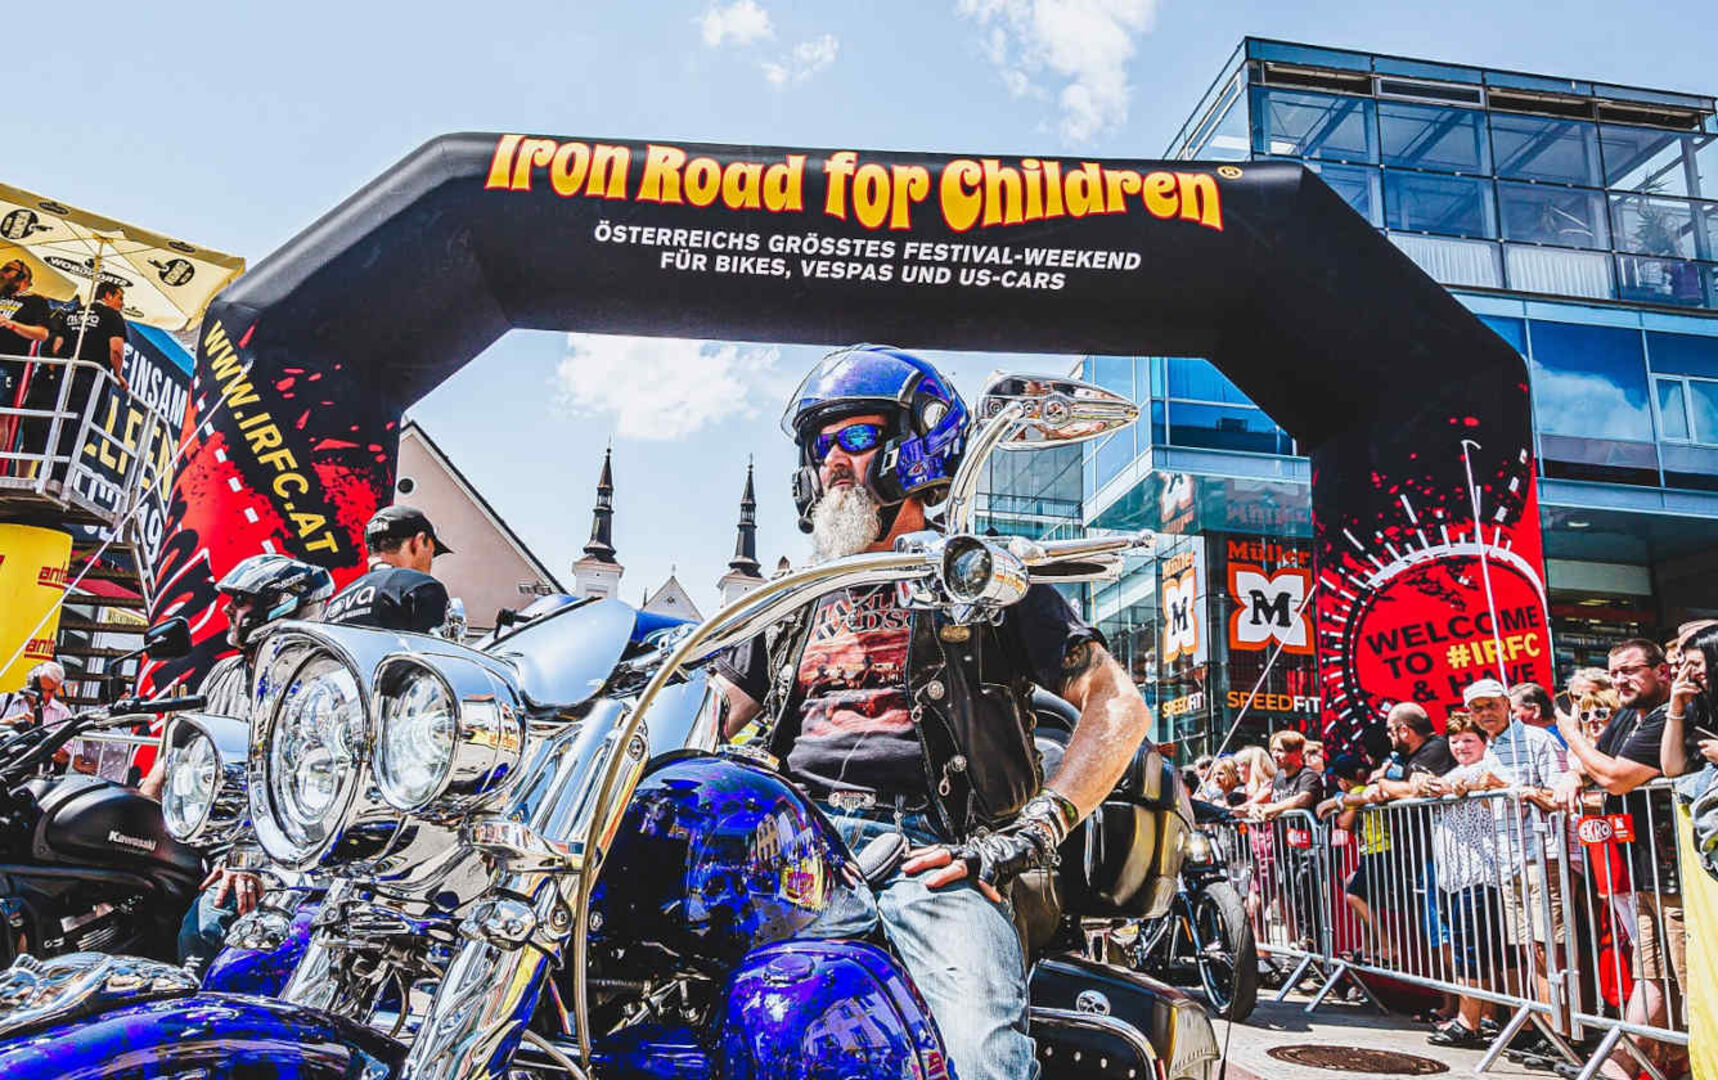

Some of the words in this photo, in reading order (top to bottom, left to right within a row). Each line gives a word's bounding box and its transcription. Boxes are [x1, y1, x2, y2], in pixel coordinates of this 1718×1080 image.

[484, 133, 631, 200] Iron
[635, 143, 808, 213] Road
[823, 151, 930, 232] for
[937, 157, 1225, 233] Children
[594, 219, 760, 251] ÖSTERREICHS
[768, 233, 896, 260] GRÖSSTES
[903, 241, 1141, 272] FESTIVAL-WEEKEND
[660, 249, 707, 274] FÜR
[715, 255, 792, 280] BIKES,
[800, 259, 893, 283] VESPAS
[901, 267, 951, 286] UND
[959, 269, 1066, 291] US-CARS
[203, 319, 339, 555] WWW.IRFC.AT
[1227, 539, 1311, 564] Müller
[1171, 596, 1188, 636] M
[1249, 589, 1292, 628] M
[1366, 605, 1541, 656] WELCOME
[1383, 651, 1434, 680] TO
[1446, 632, 1541, 670] #IRFC
[1412, 679, 1441, 703] &
